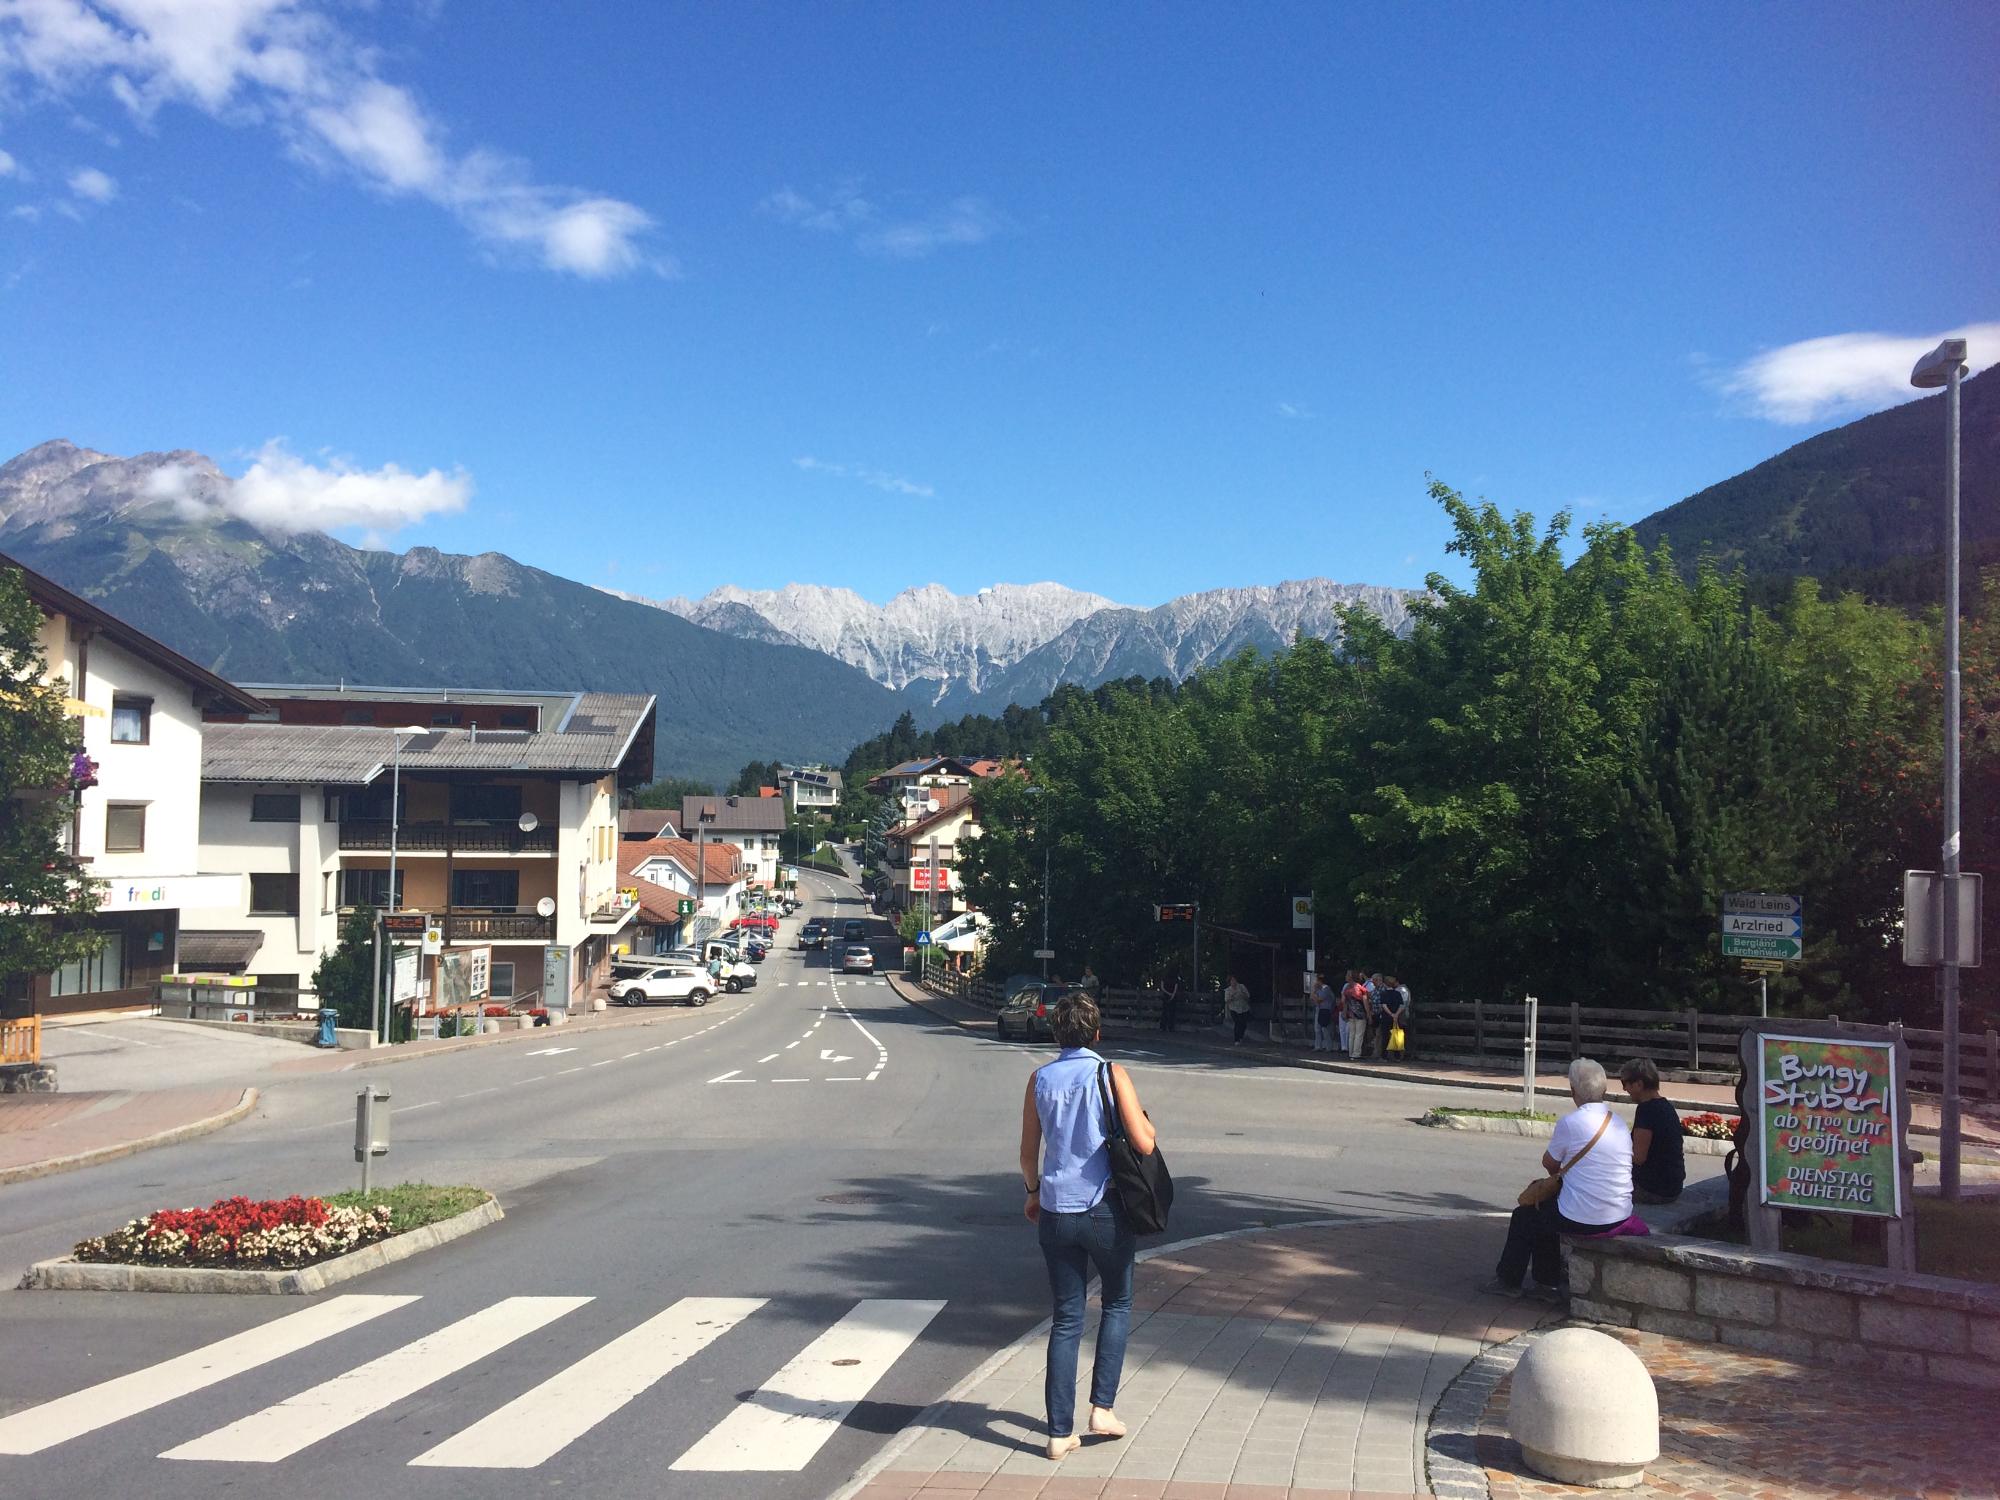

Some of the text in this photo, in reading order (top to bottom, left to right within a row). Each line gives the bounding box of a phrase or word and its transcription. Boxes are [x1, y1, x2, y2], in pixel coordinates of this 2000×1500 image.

[1732, 918, 1783, 932] Arzlried
[1733, 938, 1777, 949] Bergland
[1779, 1054, 1868, 1095] Bungy
[1765, 1080, 1889, 1114] Stüberl
[1773, 1112, 1799, 1129] ab
[1846, 1117, 1885, 1136] Uhr
[1788, 1132, 1872, 1156] geöffnet
[1787, 1166, 1873, 1187] DIENSTAG
[1789, 1181, 1873, 1202] RUHETAG
